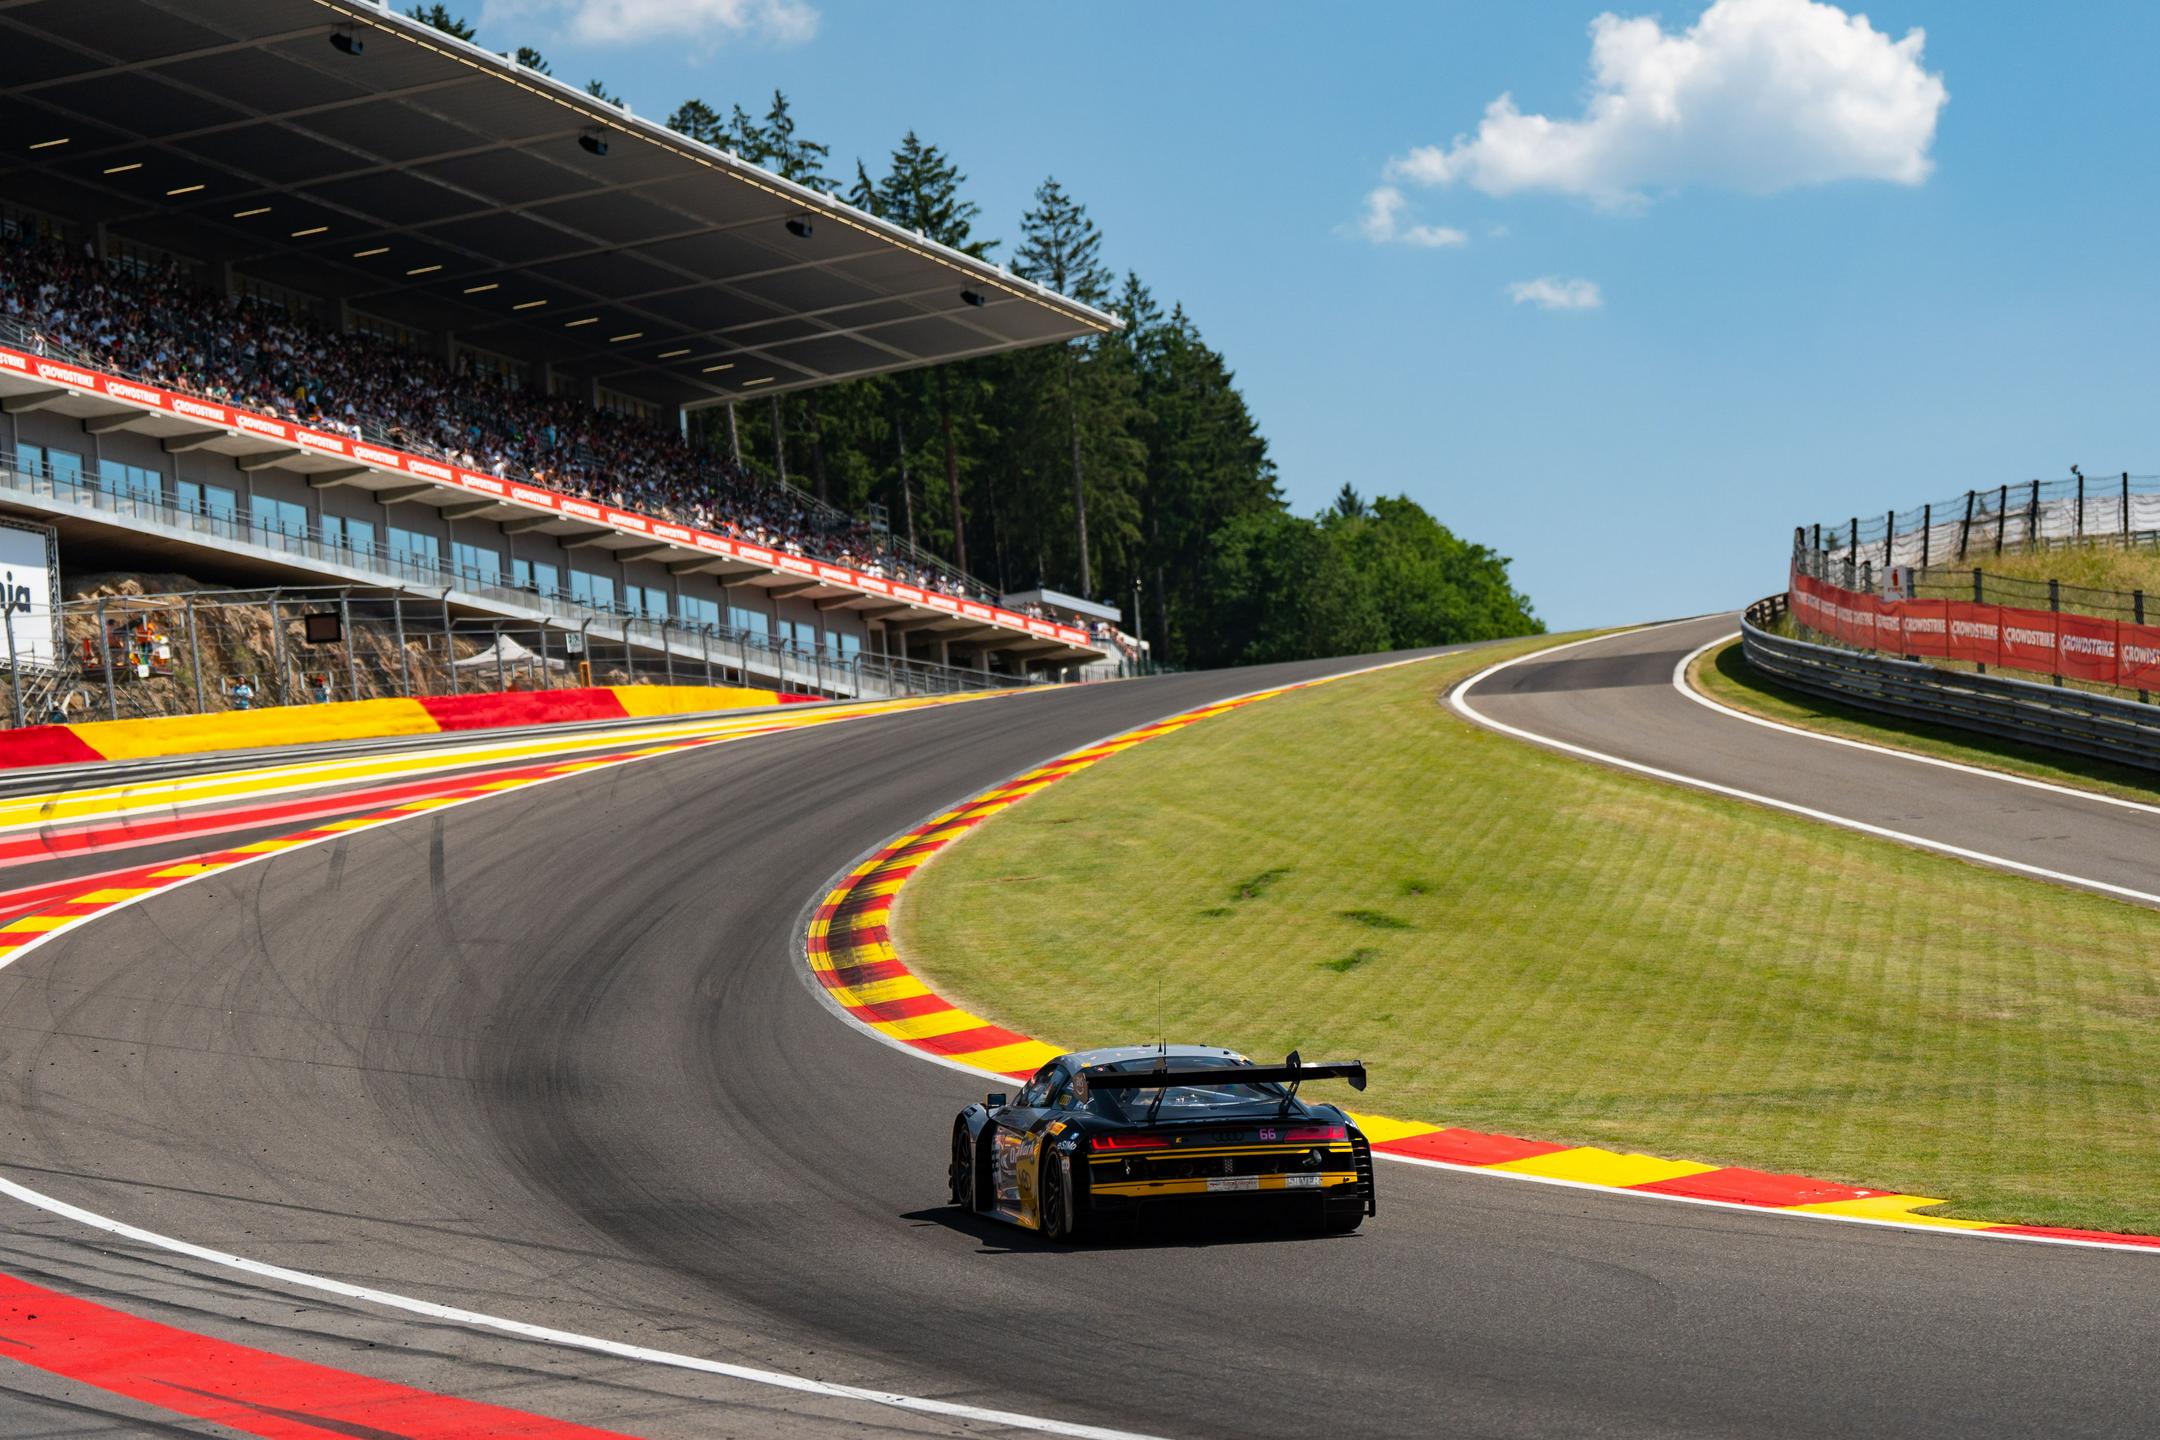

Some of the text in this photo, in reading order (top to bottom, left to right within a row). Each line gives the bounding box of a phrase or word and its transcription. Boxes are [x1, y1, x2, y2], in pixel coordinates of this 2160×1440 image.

[40, 364, 94, 388] CROWDSTRIKE
[108, 382, 161, 405] CROWDSTRIKE
[1904, 617, 1946, 633] CROWDSTRIKE
[1952, 620, 1998, 640] CROWDSTRIKE
[2006, 627, 2056, 648] CROWDSTRIKE
[2062, 635, 2115, 657] CROWDSTRIKE
[1259, 1128, 1277, 1140] 66
[1288, 1177, 1320, 1186] SILVER
